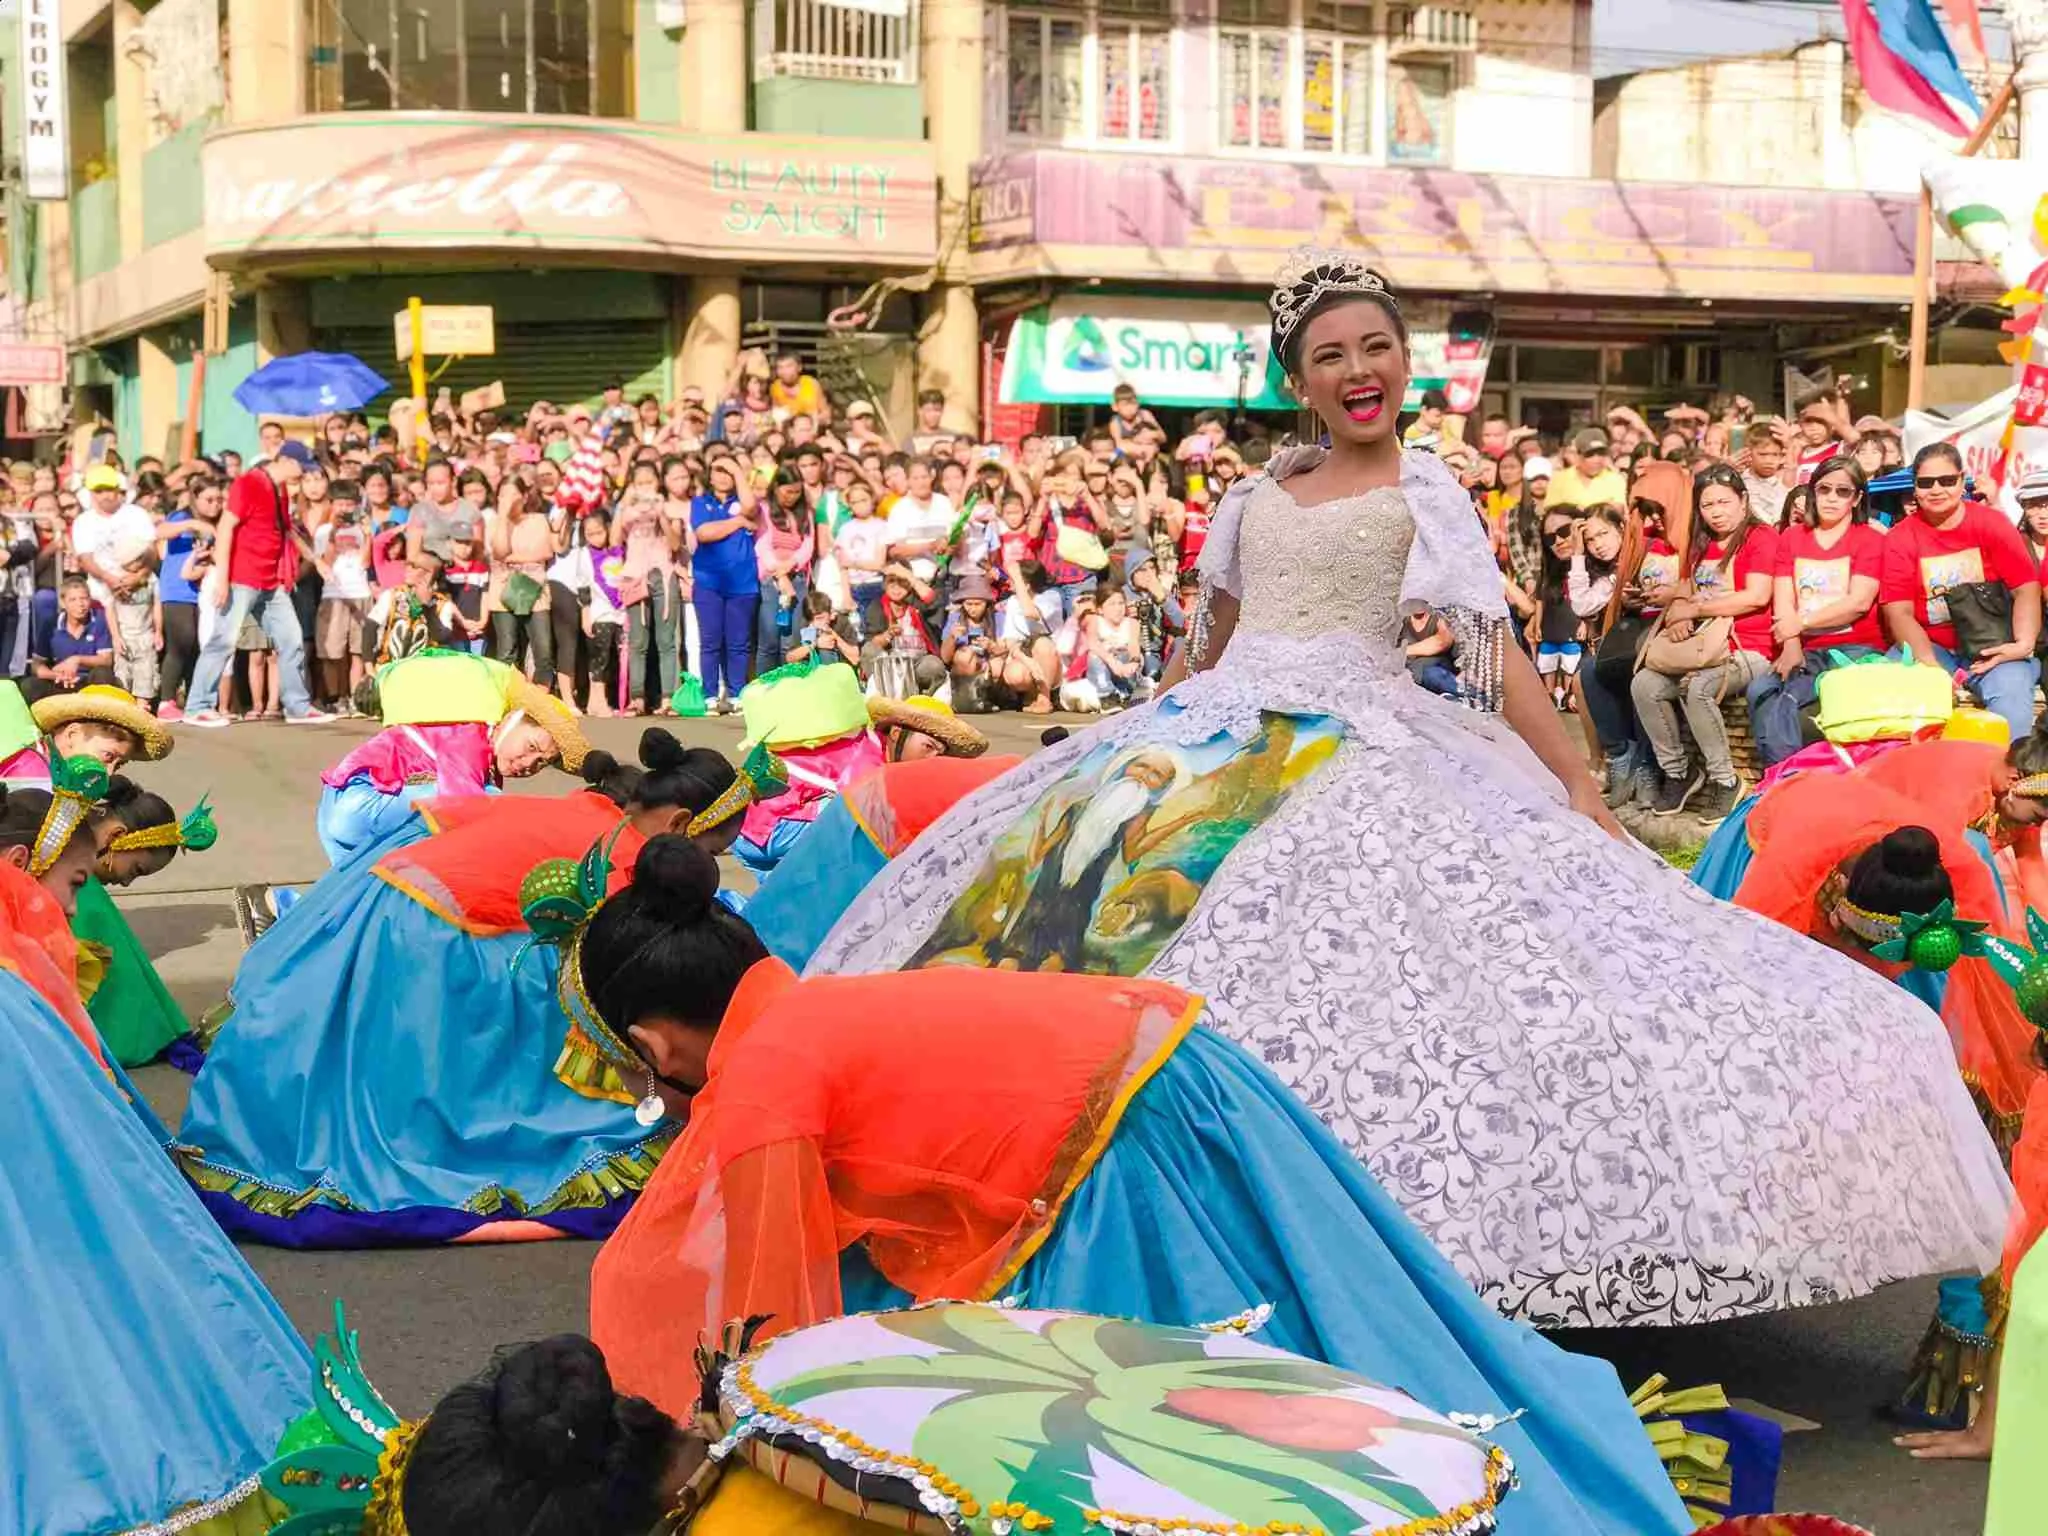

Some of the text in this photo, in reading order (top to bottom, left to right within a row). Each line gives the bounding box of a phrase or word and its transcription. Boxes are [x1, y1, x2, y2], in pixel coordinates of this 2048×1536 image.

[711, 158, 893, 199] BEAUTY
[723, 200, 886, 240] SALON
[1118, 326, 1252, 373] Smart
